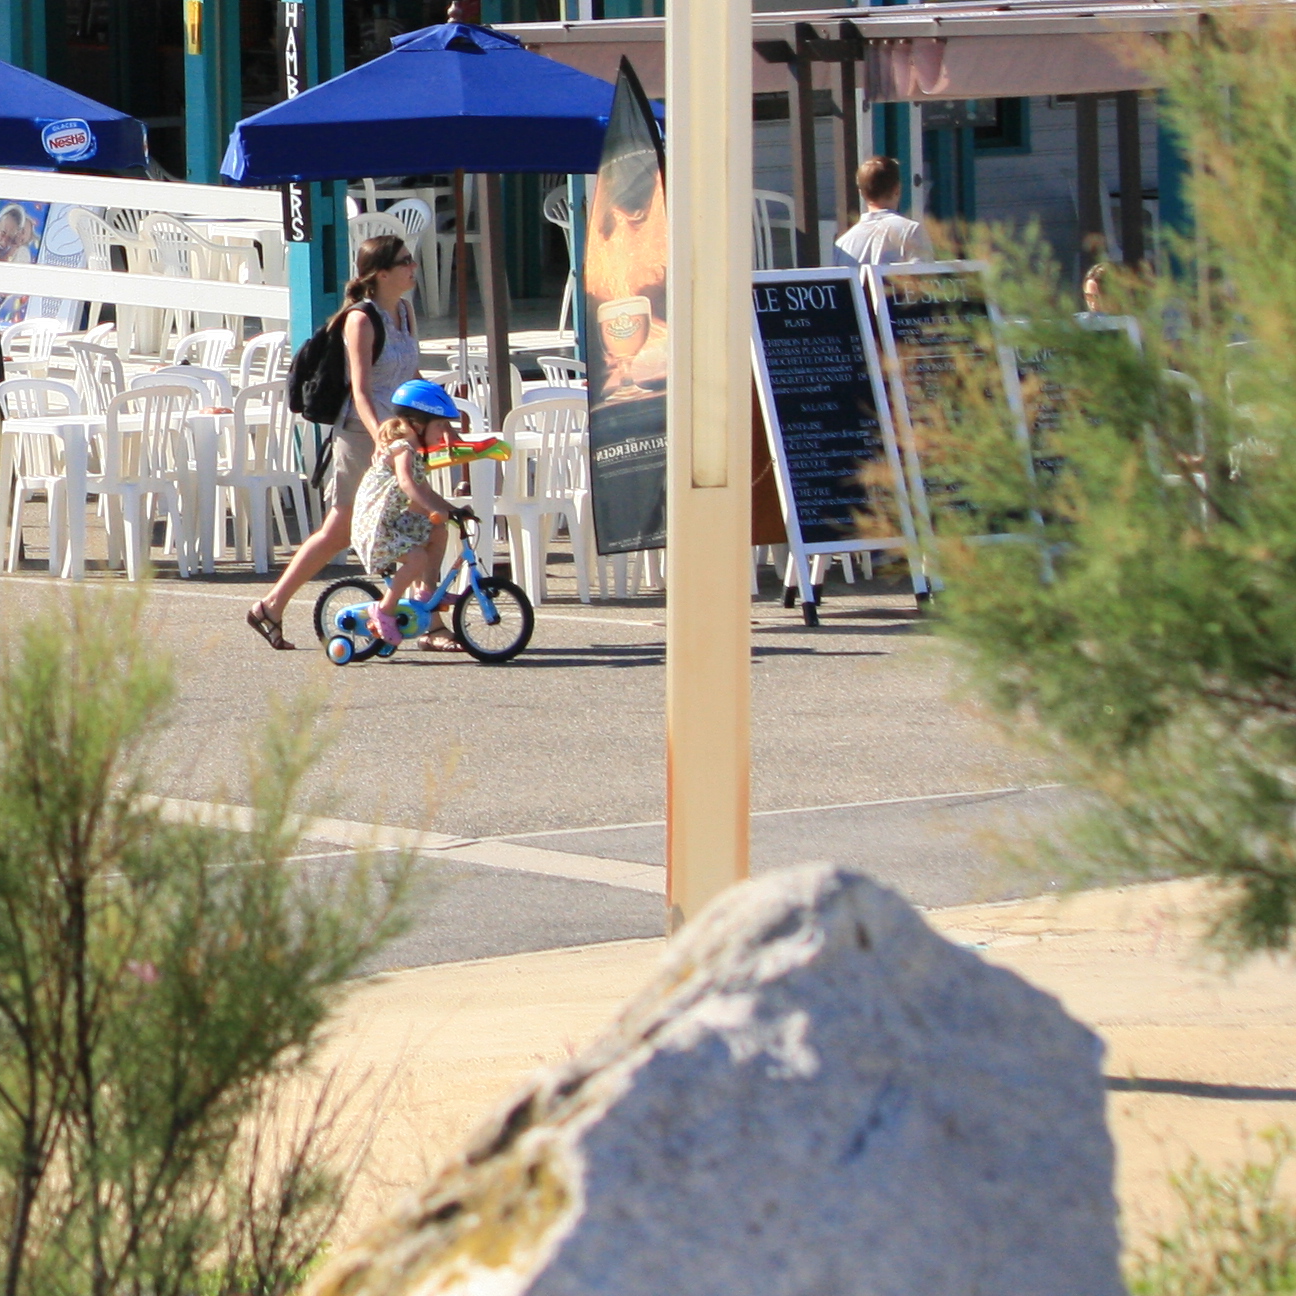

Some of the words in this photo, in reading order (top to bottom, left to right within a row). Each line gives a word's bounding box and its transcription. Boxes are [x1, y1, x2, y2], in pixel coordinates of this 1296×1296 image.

[752, 287, 781, 313] LE
[785, 285, 837, 311] SPOT
[784, 318, 811, 328] PLATS
